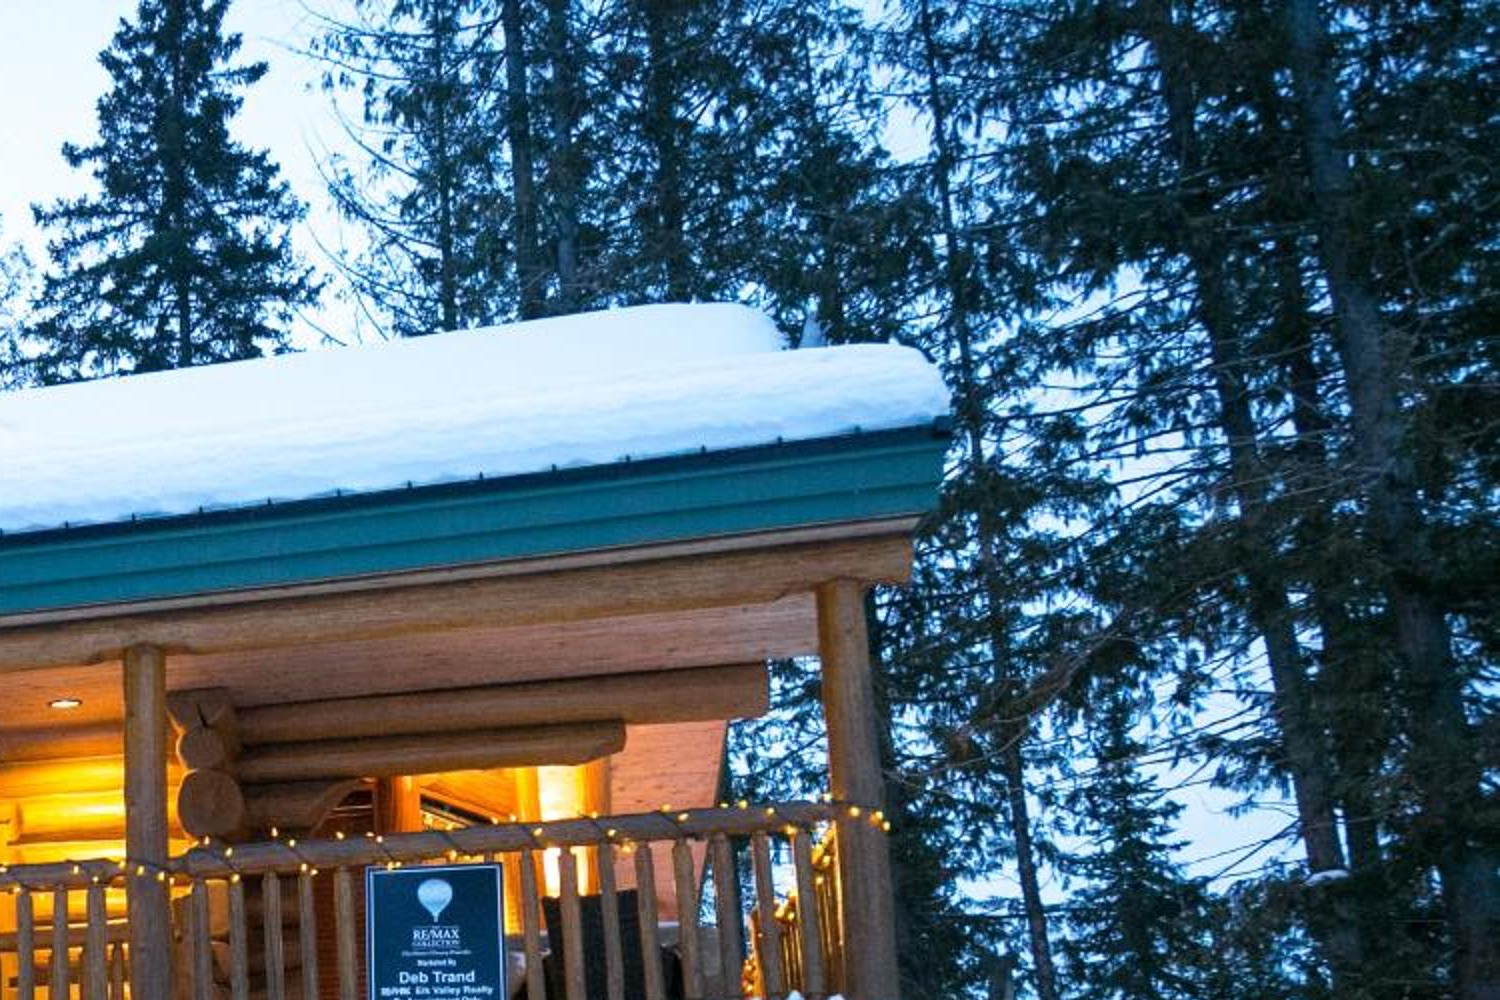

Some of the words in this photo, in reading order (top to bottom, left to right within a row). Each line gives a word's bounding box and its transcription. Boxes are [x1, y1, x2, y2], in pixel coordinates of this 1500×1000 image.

[413, 929, 460, 940] RE/MAX
[399, 971, 429, 984] Deb
[432, 970, 476, 983] Trand
